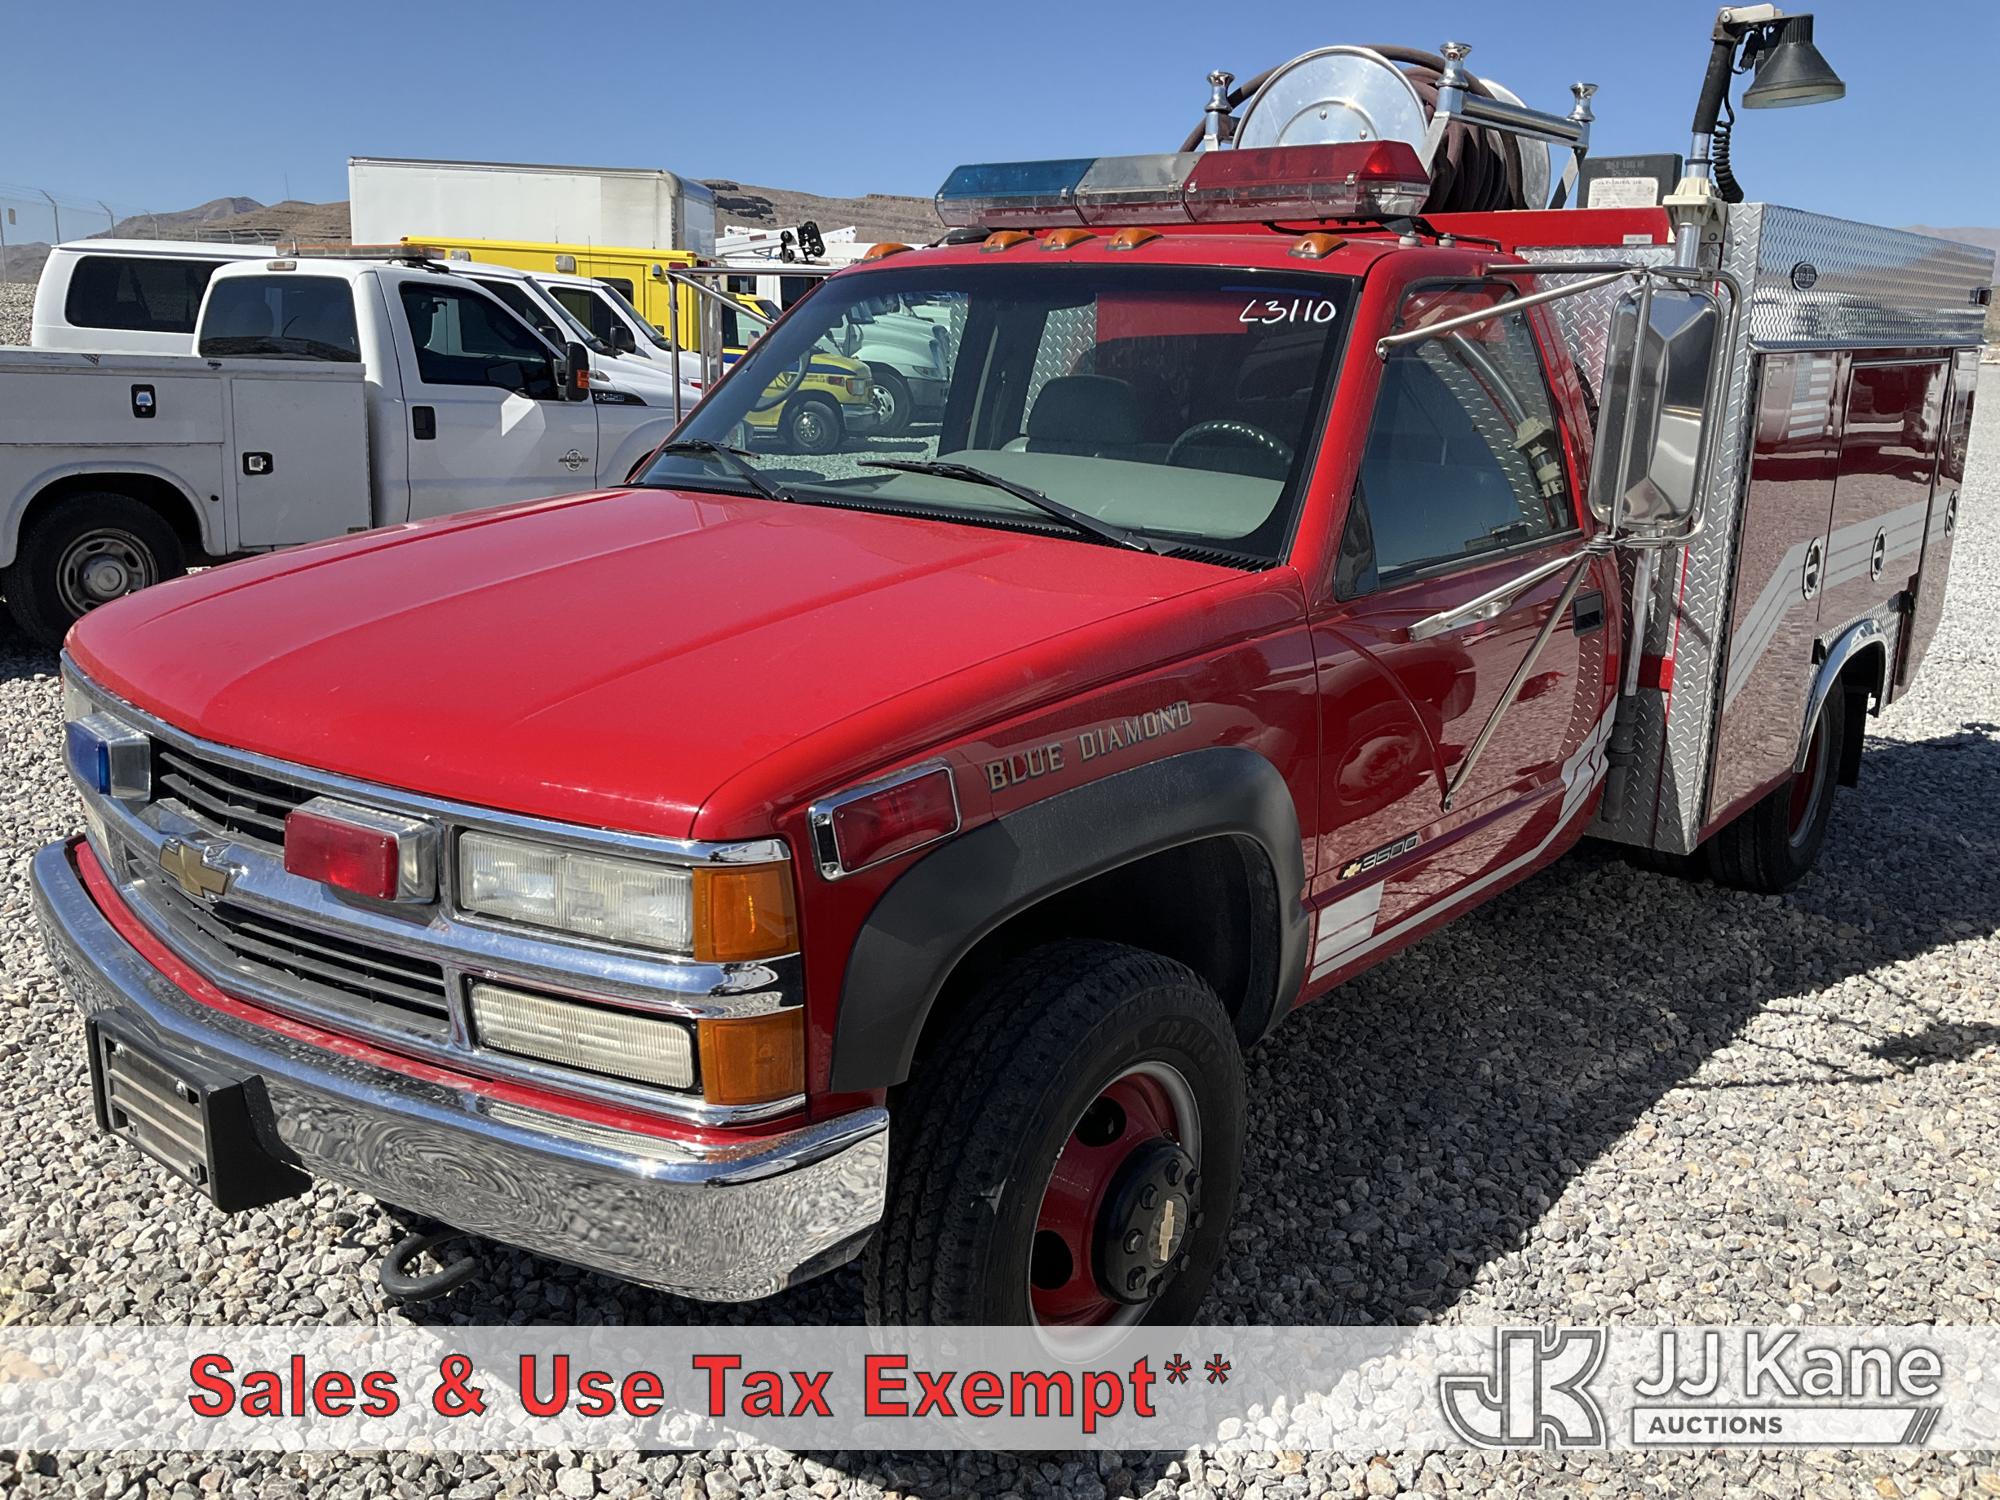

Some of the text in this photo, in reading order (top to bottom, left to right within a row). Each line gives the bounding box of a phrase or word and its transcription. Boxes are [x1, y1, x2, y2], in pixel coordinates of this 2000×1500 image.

[1239, 299, 1336, 324] L3110
[985, 700, 1192, 792] BLUE DIAMOND
[1361, 835, 1418, 872] 3500
